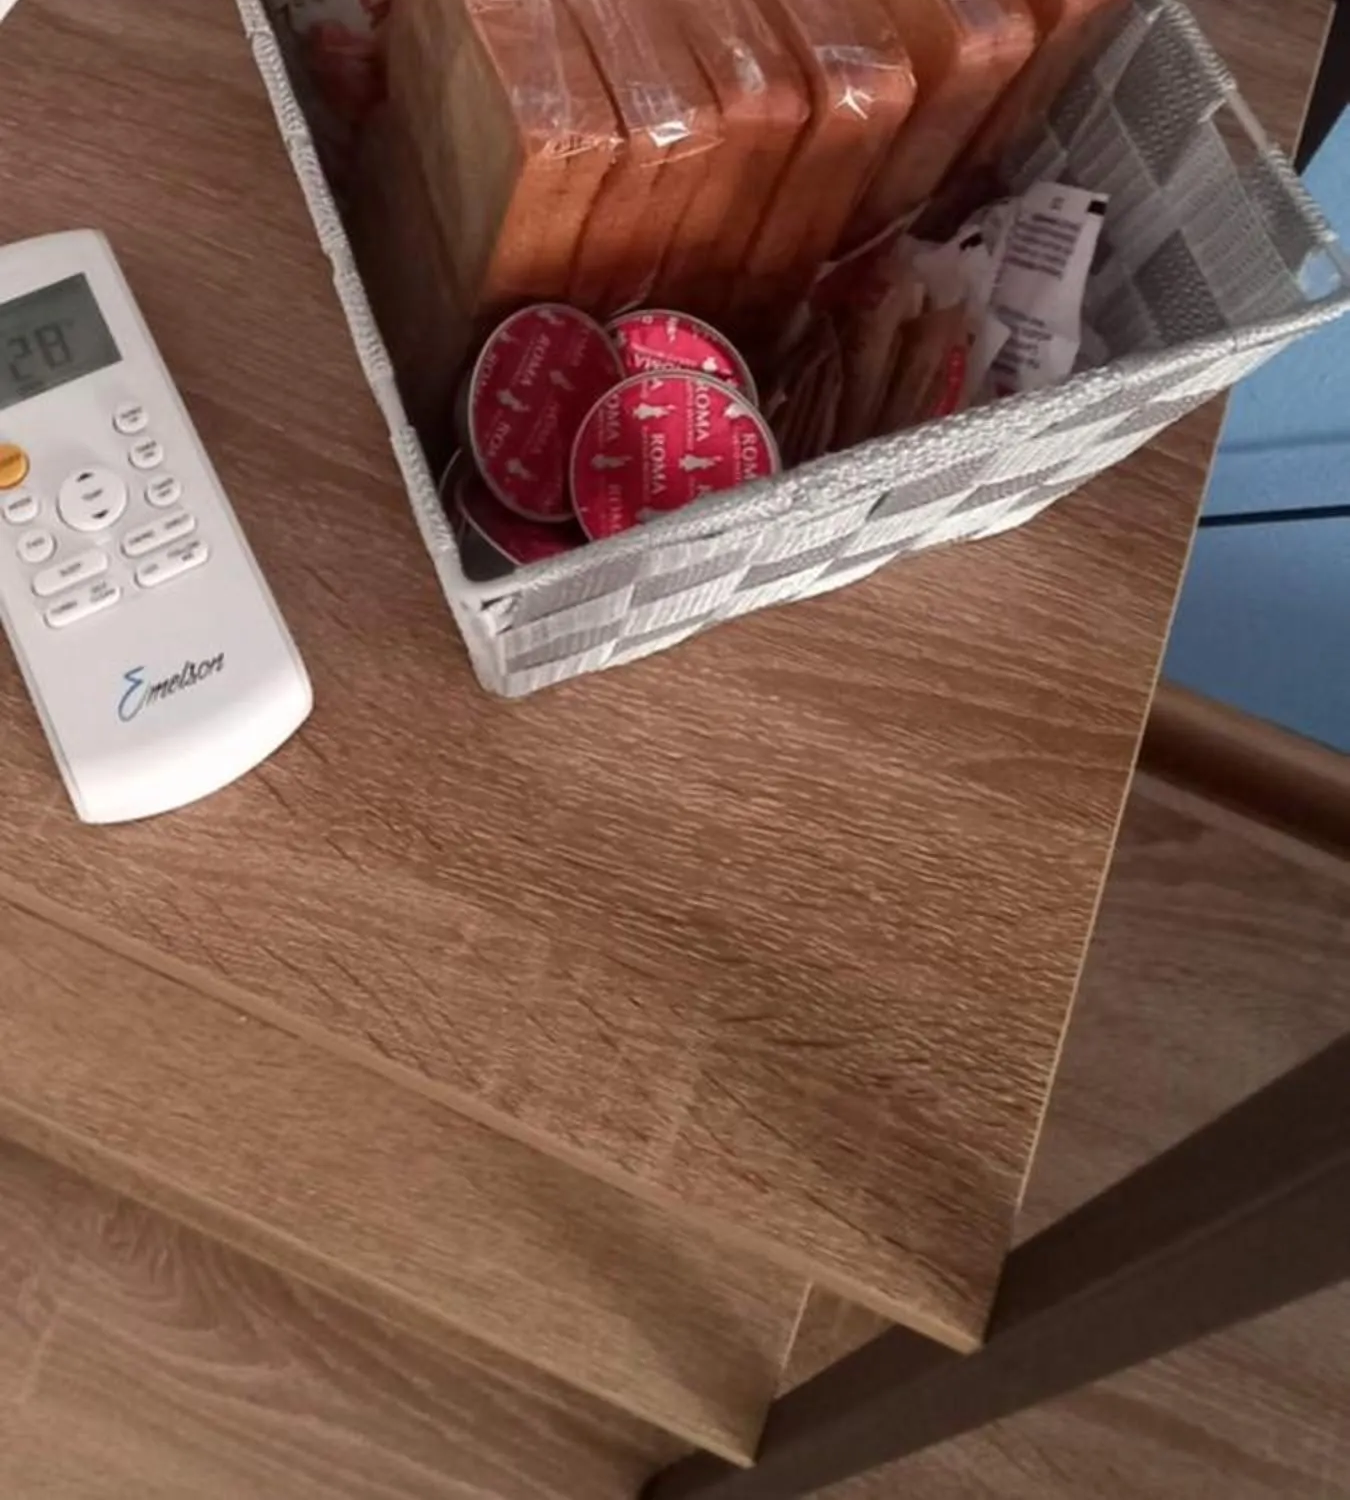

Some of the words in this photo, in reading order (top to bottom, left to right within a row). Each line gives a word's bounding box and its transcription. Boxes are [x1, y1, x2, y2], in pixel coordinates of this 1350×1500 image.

[604, 392, 621, 442] OMA
[650, 432, 667, 495] ROMA
[741, 432, 758, 480] ROM
